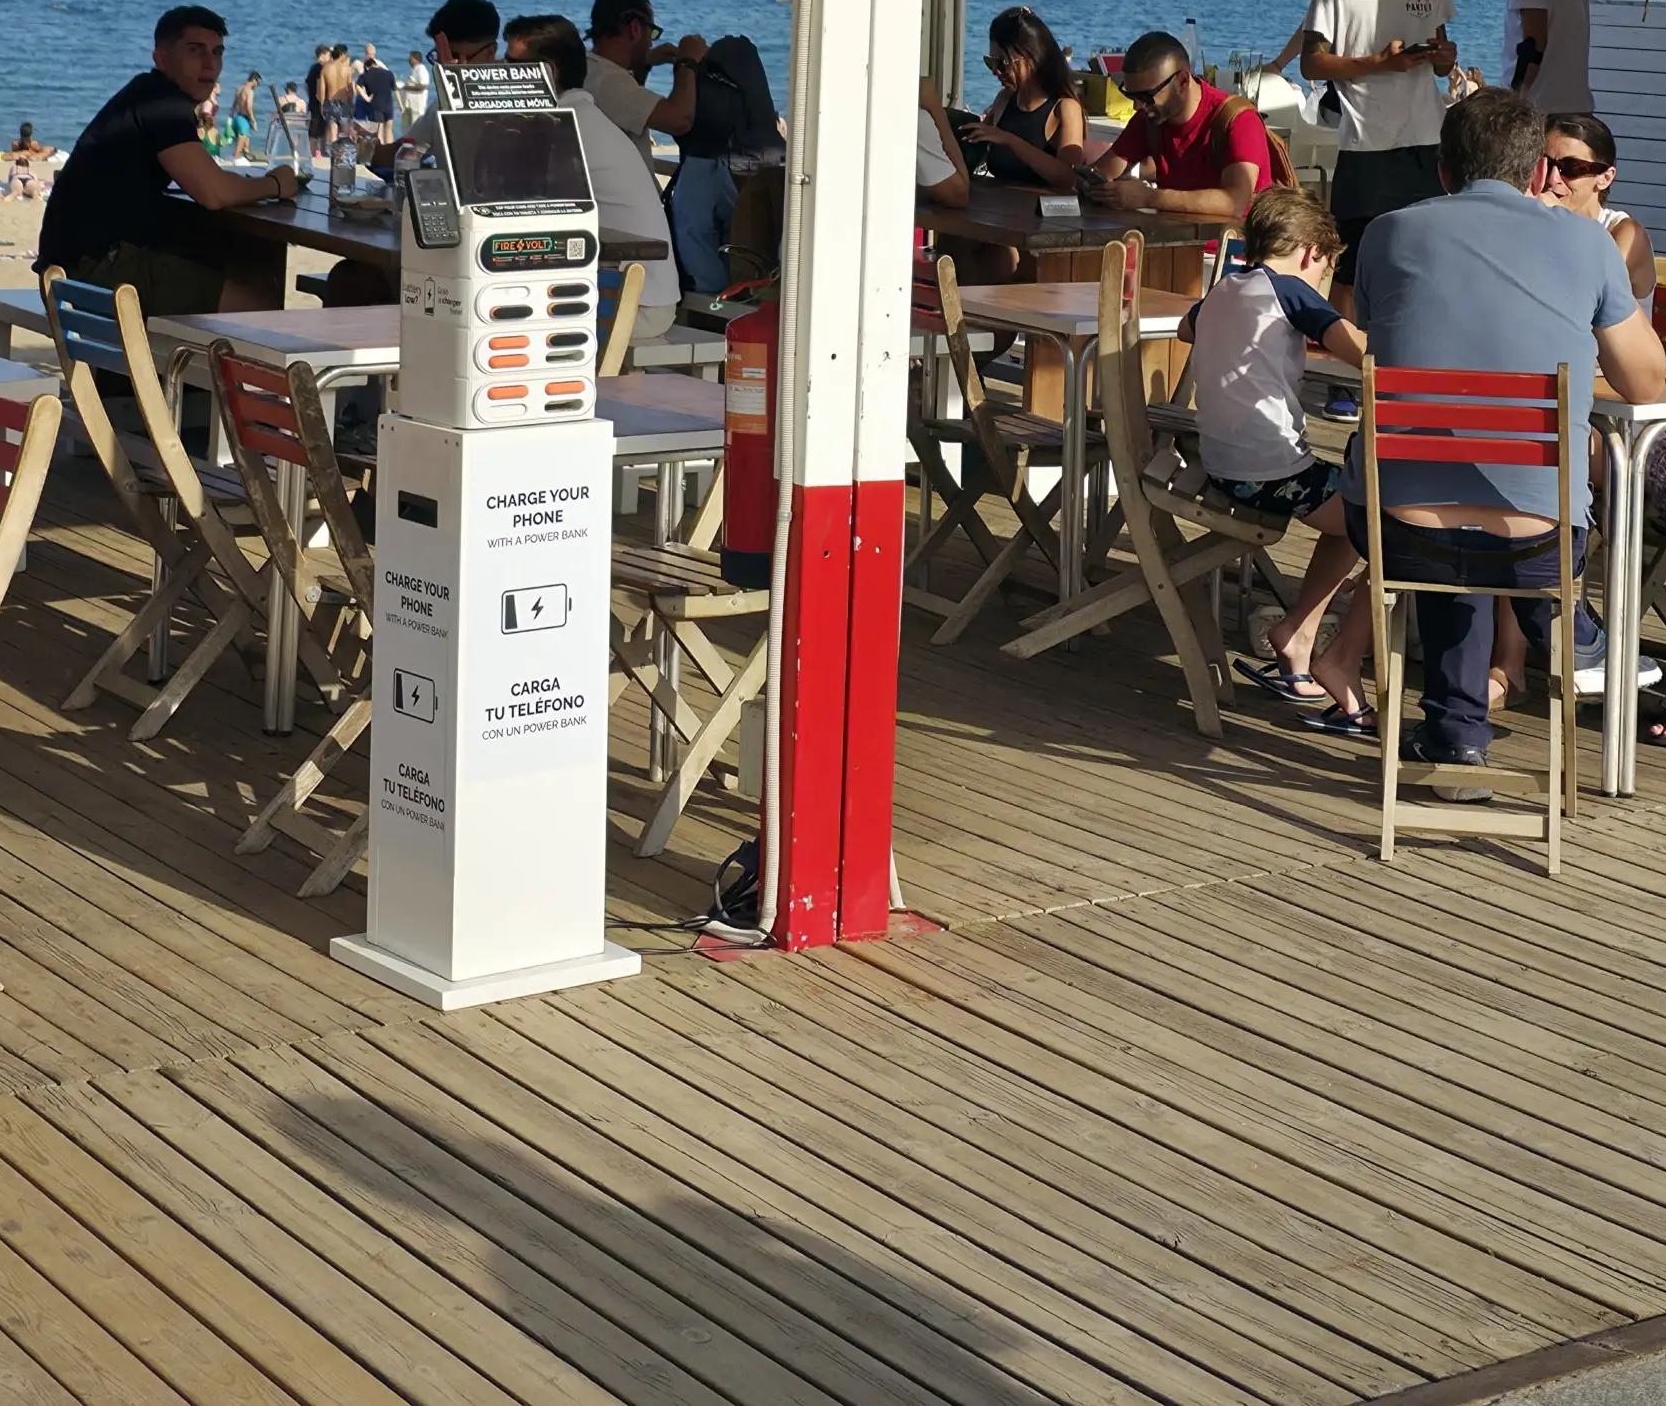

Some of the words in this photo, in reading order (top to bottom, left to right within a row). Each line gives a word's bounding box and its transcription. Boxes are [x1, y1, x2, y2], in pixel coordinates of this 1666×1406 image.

[461, 67, 508, 80] POWER
[468, 100, 513, 109] CARGADOR
[514, 100, 526, 108] DE
[526, 98, 553, 108] MÓVIL
[495, 242, 516, 250] FIRE
[525, 240, 548, 249] VOLT
[486, 491, 546, 509] CHARGE
[549, 486, 590, 502] YOUR
[513, 510, 563, 528] PHONE
[487, 537, 513, 548] WITH
[515, 536, 522, 546] A
[525, 531, 559, 544] POWER
[562, 528, 588, 540] BANK
[385, 571, 422, 593] CHARGE
[424, 581, 450, 601] YOUR
[401, 595, 433, 617] PHONE
[385, 612, 402, 625] WITH
[402, 617, 407, 627] A
[408, 619, 430, 634] POWER
[431, 626, 449, 639] BANK
[511, 677, 560, 696] CARGA
[485, 706, 505, 722] TU
[509, 695, 584, 718] TELÉFONO
[482, 729, 503, 740] CON
[506, 726, 521, 736] UN
[523, 720, 558, 734] POWER
[561, 716, 587, 728] BANK
[399, 763, 430, 787] CARGA
[383, 778, 396, 794] TU
[397, 786, 445, 813] TELÉFONO
[381, 799, 394, 811] CON
[396, 804, 405, 816] UN
[406, 808, 429, 825] POWER
